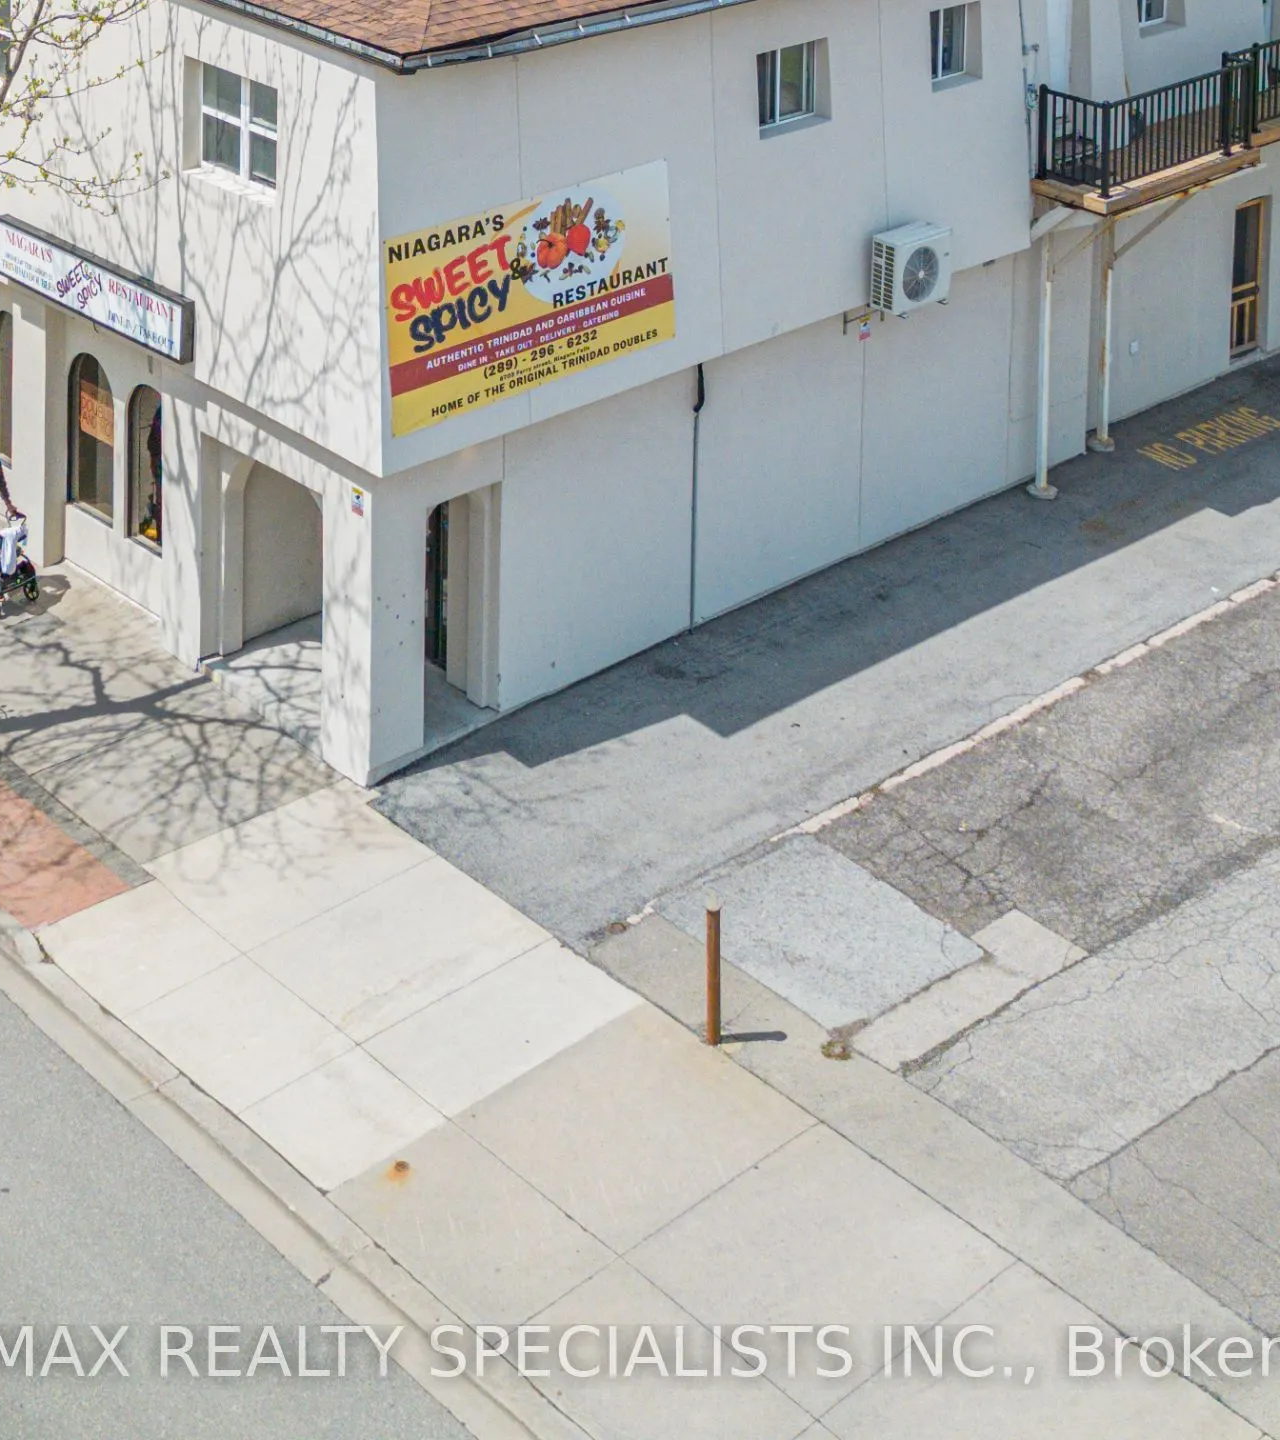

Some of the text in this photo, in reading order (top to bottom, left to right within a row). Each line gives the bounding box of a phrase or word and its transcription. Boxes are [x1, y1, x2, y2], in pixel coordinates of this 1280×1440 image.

[388, 214, 505, 263] NIAGARA'S
[56, 260, 87, 298] SWEET
[77, 273, 102, 310] SPICY
[108, 278, 175, 323] RESTAURANT
[391, 235, 528, 322] SWEET &
[553, 257, 668, 309] RESTAURANT
[410, 274, 511, 353] SPICY
[426, 287, 646, 370] AUTHENTIC TRINIDAD AND CARIBBEAN CUISINE
[458, 310, 619, 372] DINE IN TAKE OUT DELIVERY CATERING
[483, 357, 519, 379] (289)
[530, 344, 555, 362] 296
[567, 329, 598, 348] 6232
[431, 328, 659, 417] HOME OF THE ORIGINAL TRINIDAD DOUBLES
[1136, 442, 1199, 471] NO
